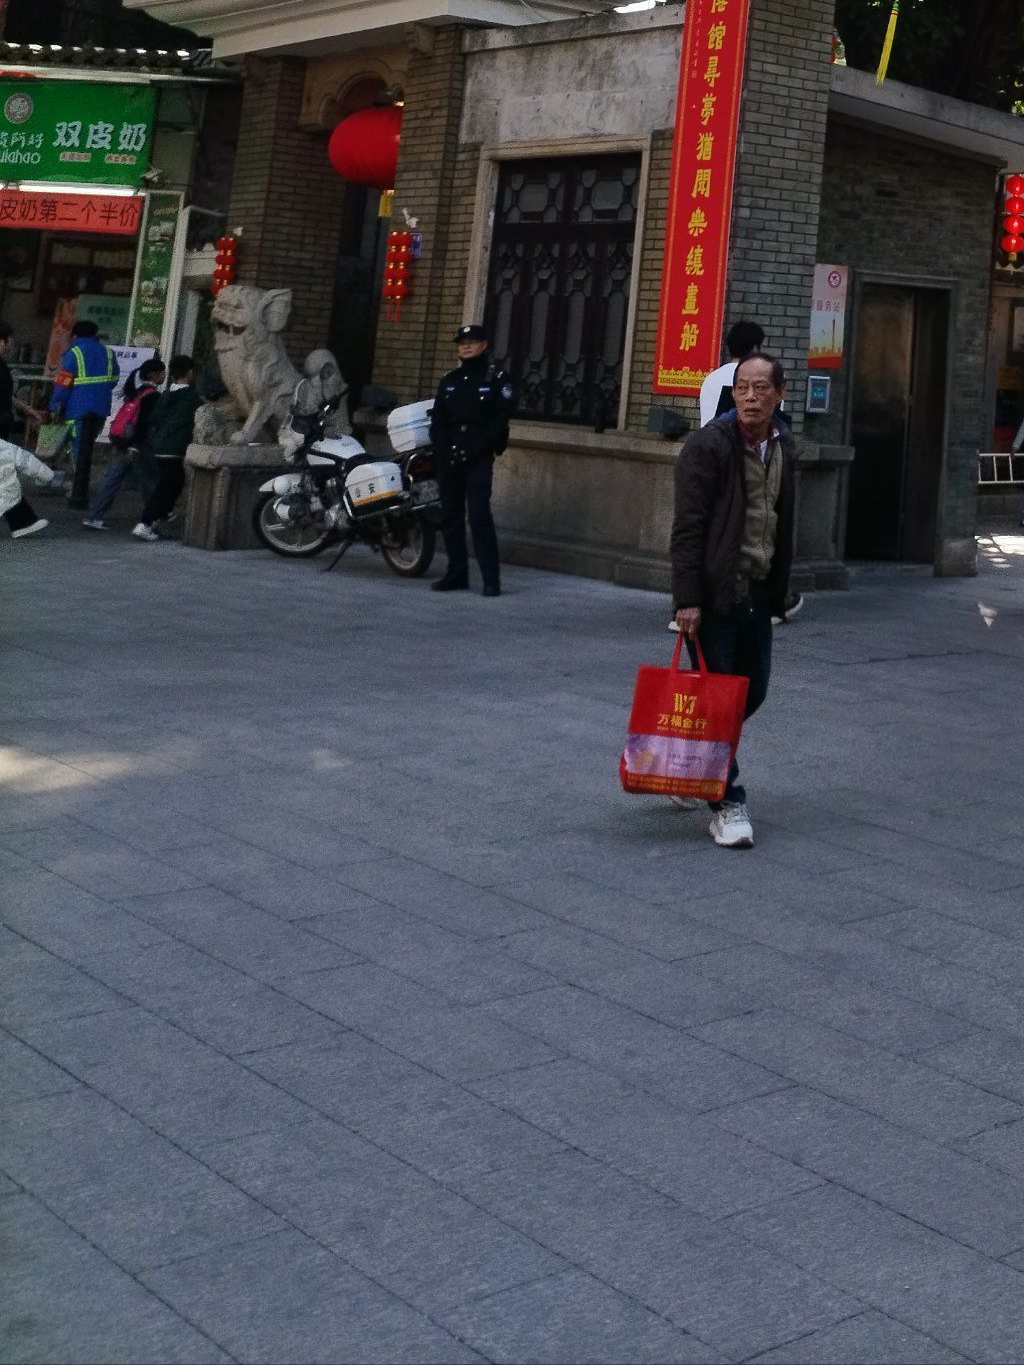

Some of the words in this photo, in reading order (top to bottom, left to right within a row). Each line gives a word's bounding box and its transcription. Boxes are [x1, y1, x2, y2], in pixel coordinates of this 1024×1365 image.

[52, 120, 147, 152] 双皮奶
[1, 197, 139, 227] 皮奶第二个半价
